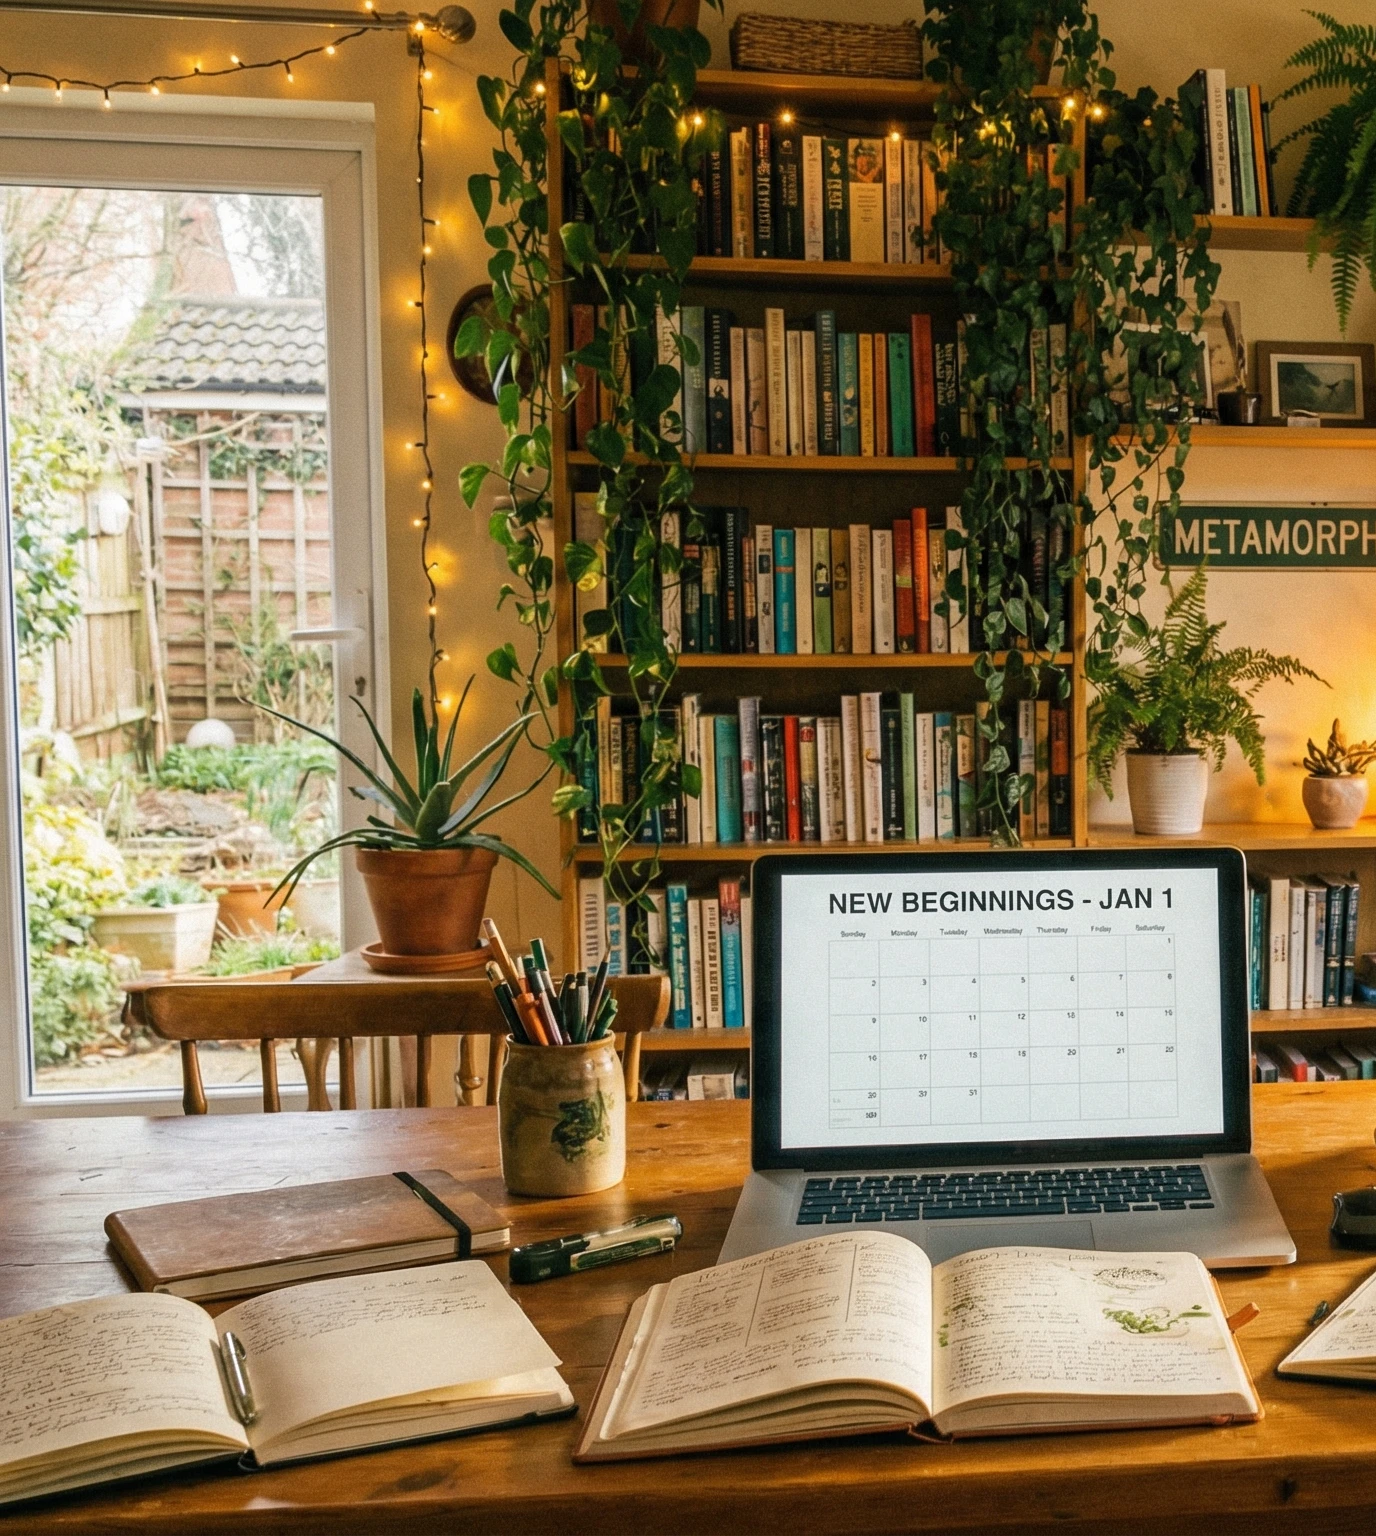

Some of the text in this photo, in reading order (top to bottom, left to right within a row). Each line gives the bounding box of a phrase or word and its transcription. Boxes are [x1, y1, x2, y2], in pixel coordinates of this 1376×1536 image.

[829, 892, 893, 915] NEW
[902, 889, 1074, 914] BEGINNINGS
[1099, 887, 1152, 910] JAN
[1162, 887, 1173, 909] 1
[918, 1015, 928, 1023] 10
[1017, 1013, 1026, 1021] 12
